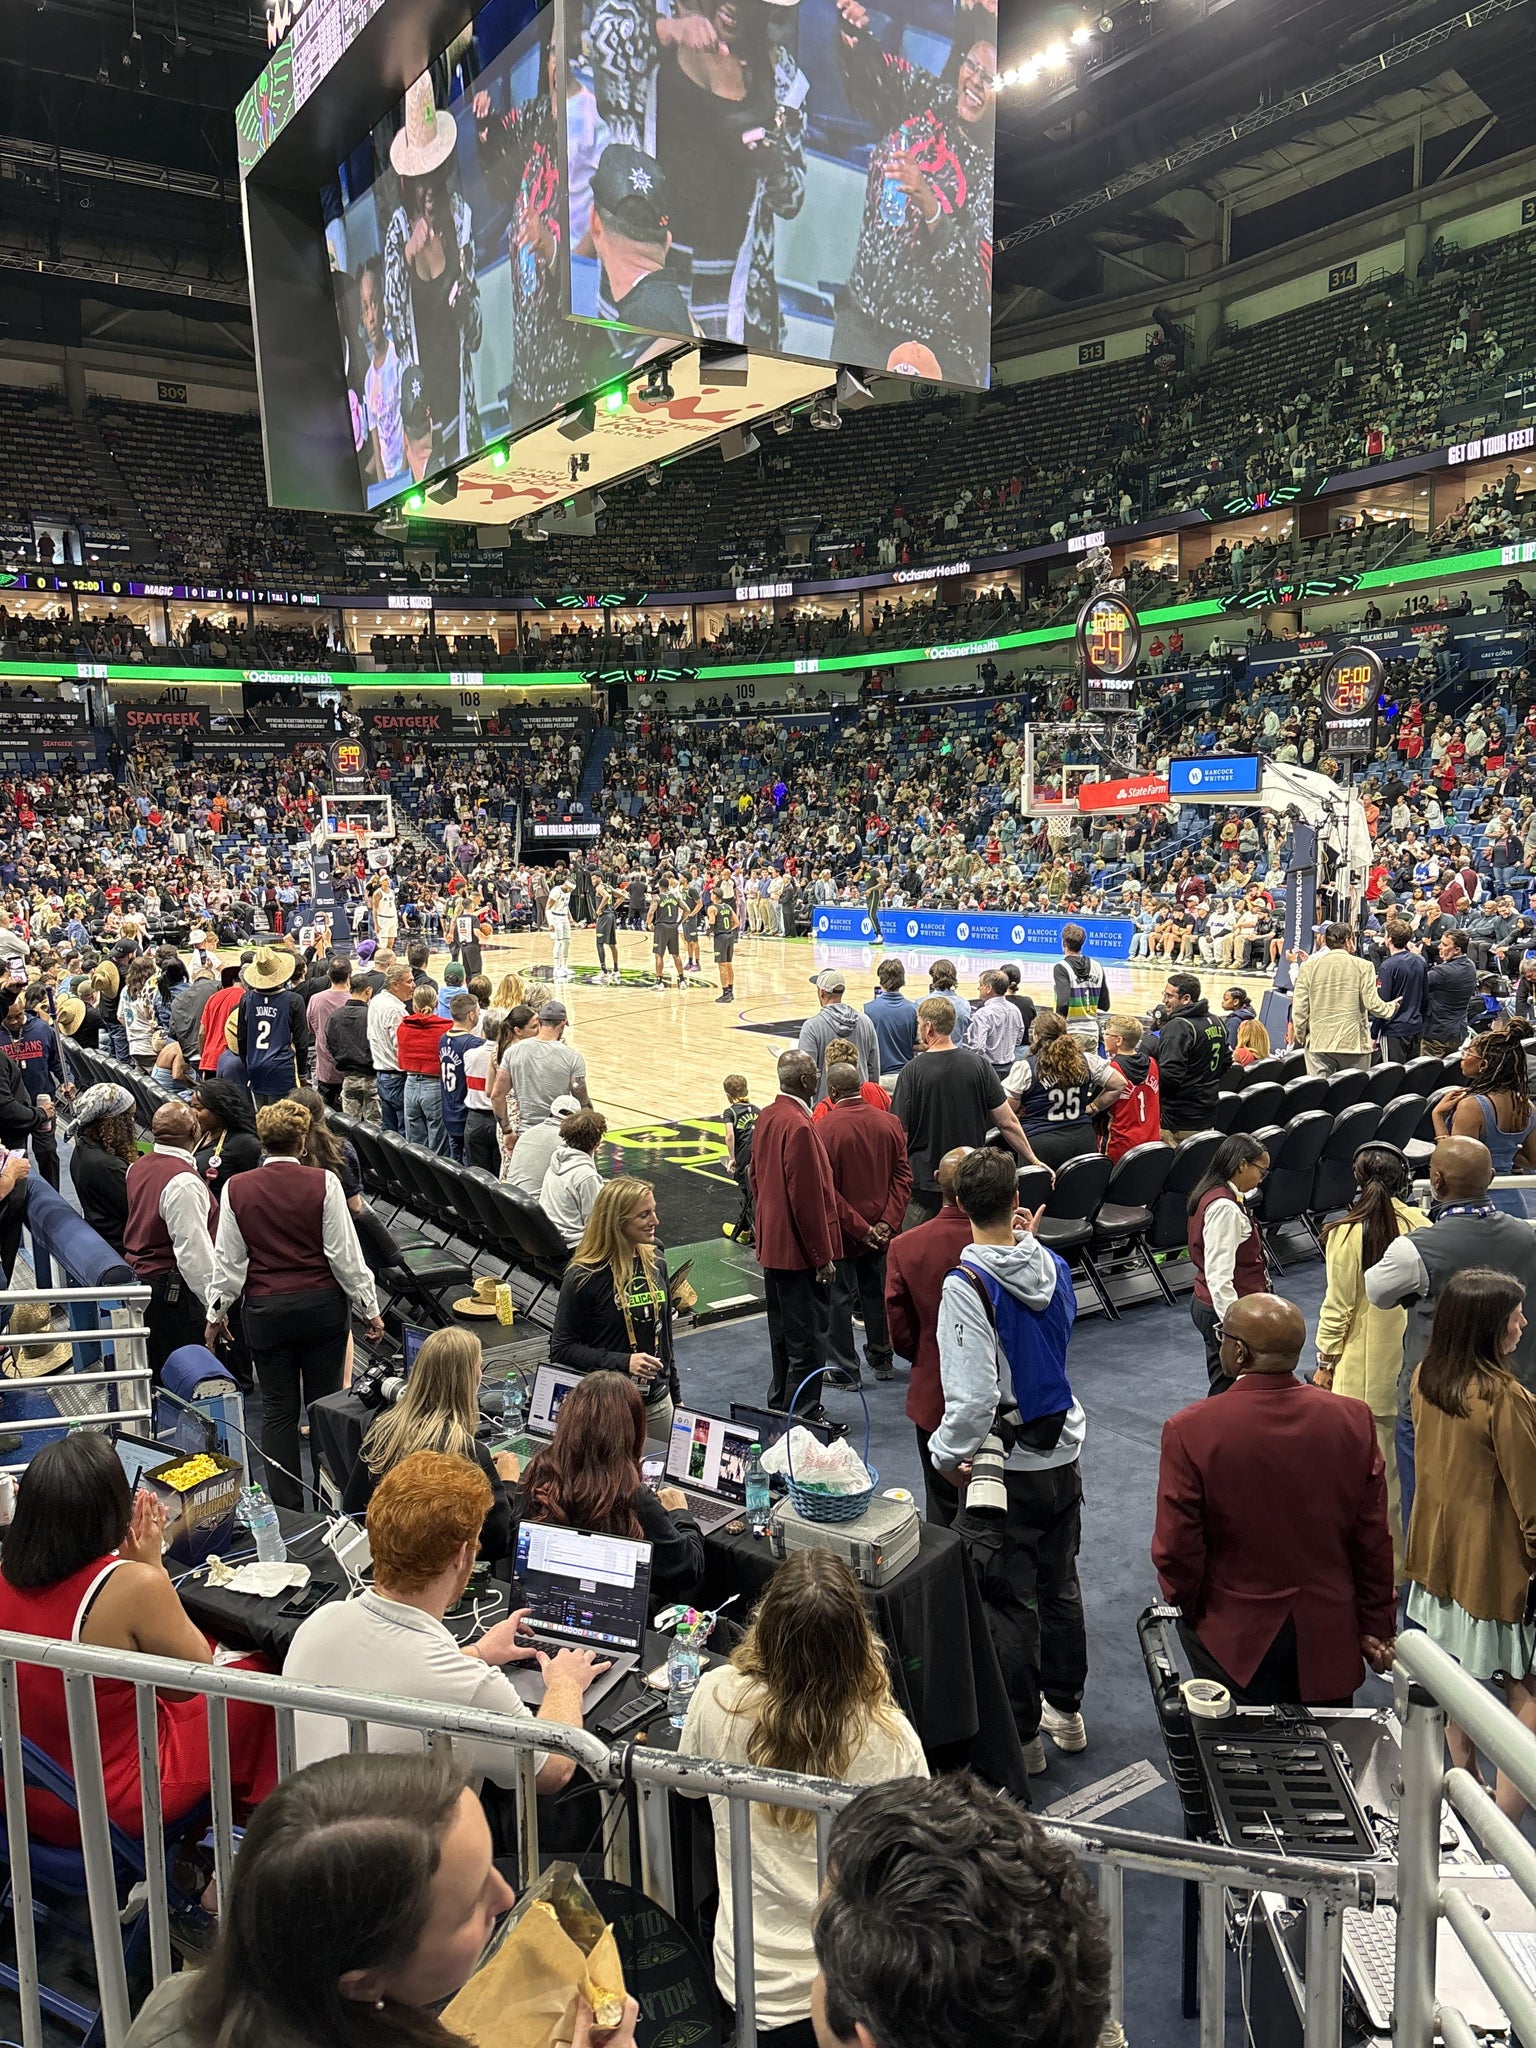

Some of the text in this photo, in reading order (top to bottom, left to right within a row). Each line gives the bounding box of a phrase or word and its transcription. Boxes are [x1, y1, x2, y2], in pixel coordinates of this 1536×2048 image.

[1331, 267, 1354, 287] 314
[1081, 346, 1102, 360] 313
[159, 386, 186, 400] 309
[596, 409, 719, 432] SMOOTHIE
[599, 421, 668, 434] KING
[1448, 427, 1534, 465] GET ON YOUR FEET!
[37, 577, 46, 589] 0
[72, 580, 99, 591] 12:00
[112, 582, 121, 593] 0
[144, 585, 173, 596] MAGIC
[1361, 633, 1383, 643] PELICANS
[1383, 631, 1398, 639] RADIO
[1091, 632, 1122, 665] 24
[1338, 666, 1371, 684] 12:00
[736, 683, 755, 699] 109
[1100, 678, 1134, 690] TISSOT
[166, 687, 188, 702] 107
[459, 691, 480, 707] 108
[1339, 684, 1364, 706] 24
[127, 711, 201, 727] SEATGEEK
[373, 714, 441, 729] SEATGEEK
[1339, 718, 1372, 729] TISSOT
[42, 740, 74, 748] SEATGEEK
[339, 746, 359, 756] 12:00
[338, 756, 359, 771] 24
[534, 824, 601, 836] NEW ORLEANS PELICANS
[667, 905, 672, 917] 1
[723, 917, 730, 929] 0
[971, 925, 999, 933] HANCOCK
[1027, 928, 1058, 937] HANCOCK
[1089, 931, 1123, 940] HANCOCK
[1084, 989, 1090, 1012] 1
[255, 1005, 278, 1018] JONES
[256, 1020, 271, 1050] 2
[1204, 1025, 1222, 1040] POOLE
[1210, 1042, 1221, 1072] 3
[441, 1061, 457, 1092] 15
[1047, 1086, 1081, 1121] 25
[1137, 1091, 1146, 1122] 1
[629, 1292, 662, 1305] ELICAS
[193, 1478, 235, 1508] NEW ORLEANS
[194, 1494, 234, 1521] PELICANS
[639, 1977, 697, 2022] NOLA
